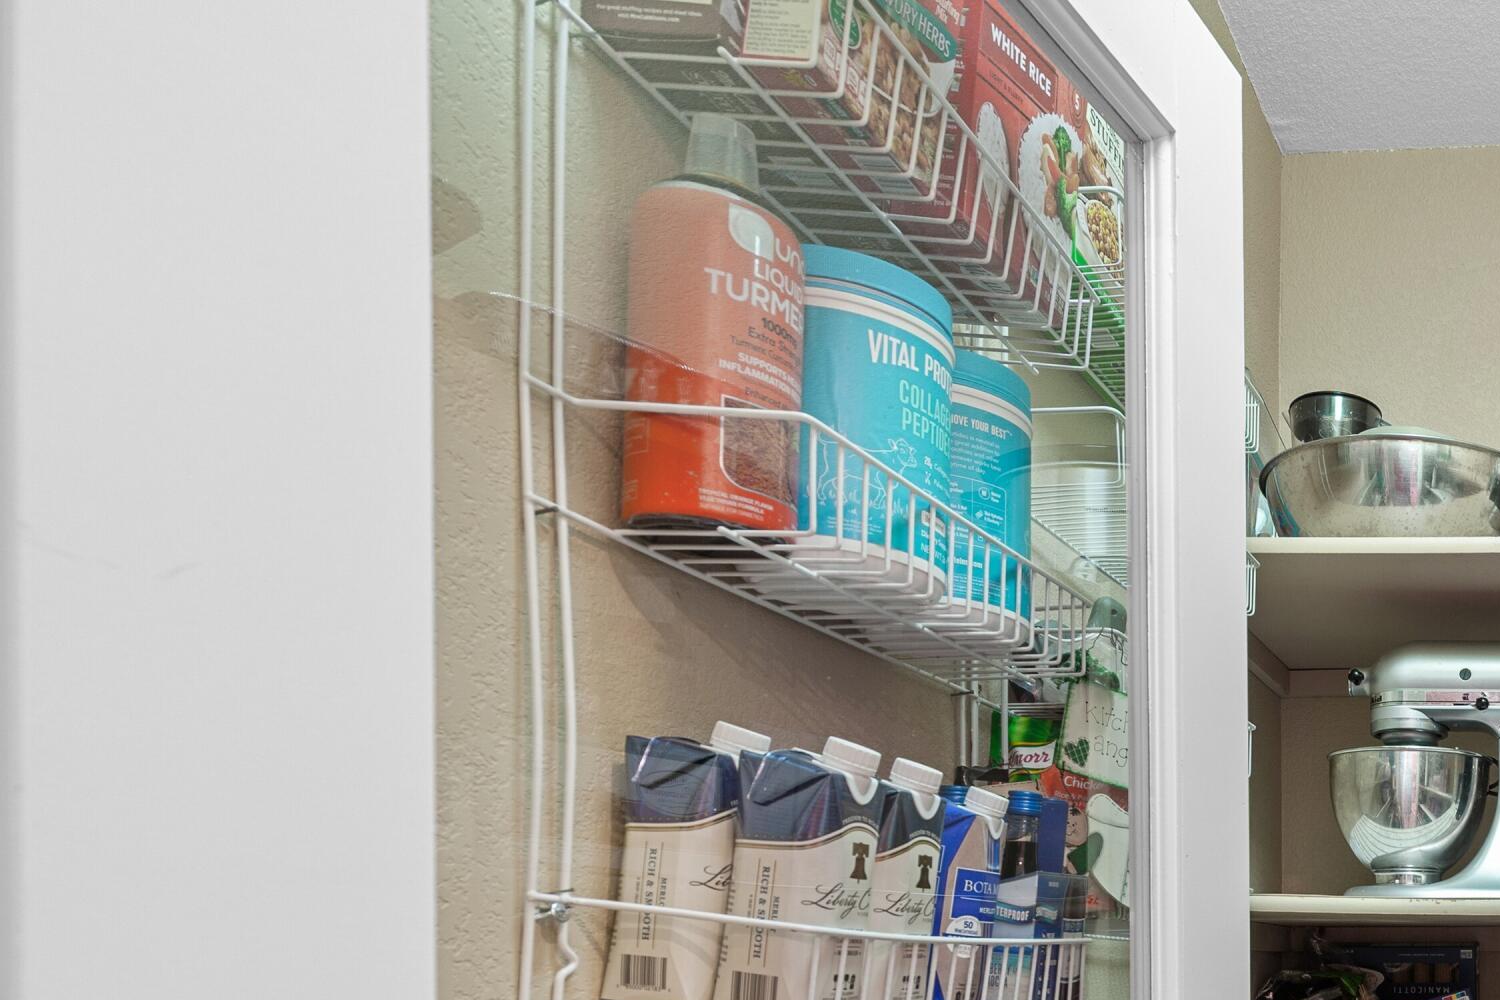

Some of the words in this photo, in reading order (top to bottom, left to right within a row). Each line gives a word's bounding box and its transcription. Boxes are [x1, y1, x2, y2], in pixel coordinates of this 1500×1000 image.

[919, 15, 952, 58] HERBS
[990, 22, 1028, 73] WHITE
[1027, 61, 1053, 97] RICE
[1073, 93, 1080, 111] 5
[703, 267, 804, 336] TURME
[867, 328, 920, 372] VITAL
[647, 848, 658, 877] RICH
[659, 877, 668, 907] MERLO
[759, 865, 770, 894] RICH
[758, 897, 767, 905] &
[770, 895, 780, 934] MERLT
[801, 882, 859, 920] Liberty
[873, 892, 924, 925] Liberty
[963, 921, 974, 930] 50
[1392, 985, 1451, 995] MANICOTTI
